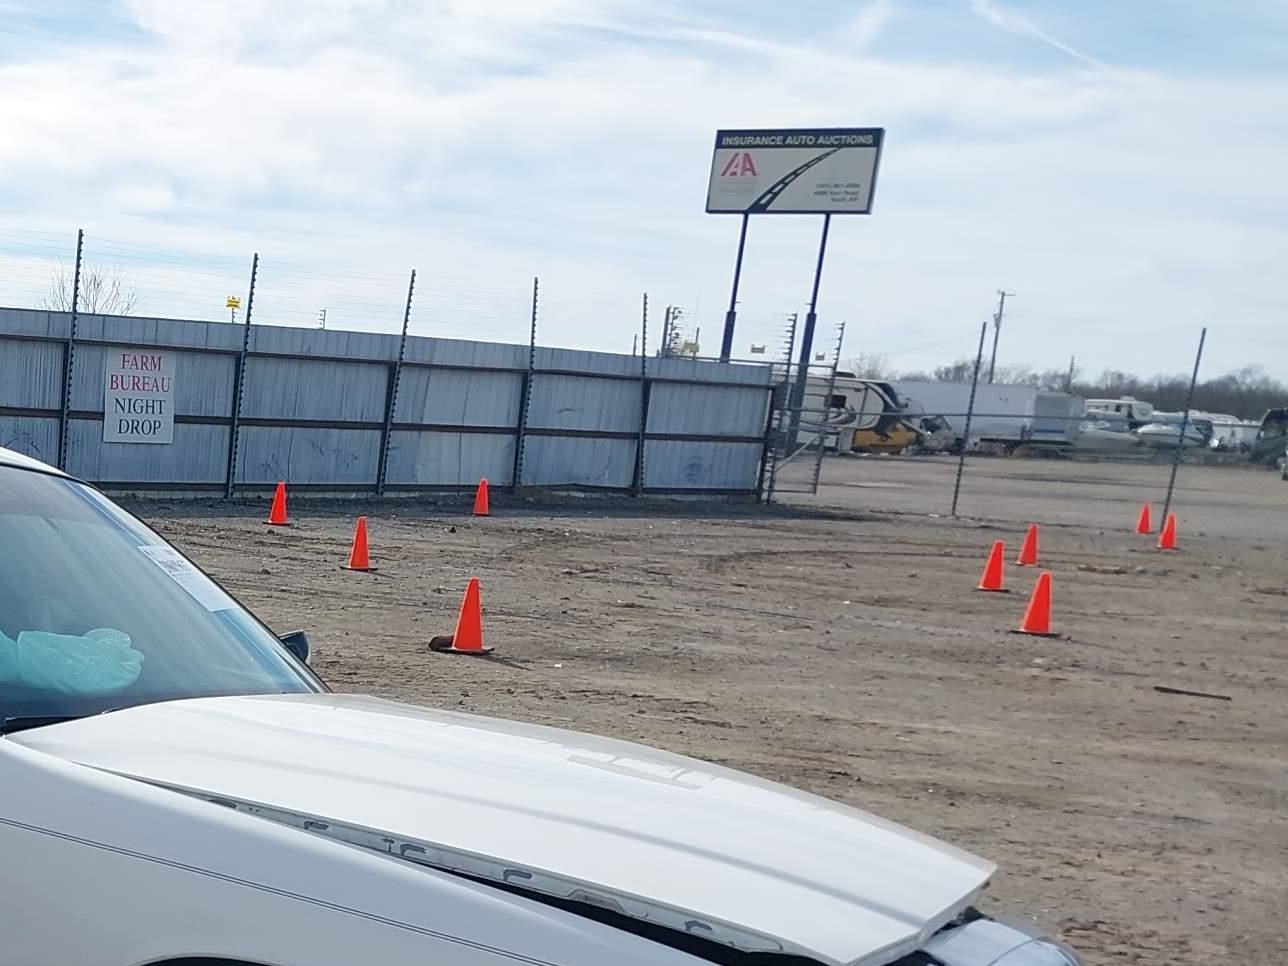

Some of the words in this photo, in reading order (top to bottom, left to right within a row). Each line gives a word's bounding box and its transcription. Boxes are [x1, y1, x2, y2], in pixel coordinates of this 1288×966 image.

[721, 135, 784, 146] INSURANCE
[785, 135, 816, 145] AUTO
[816, 134, 874, 145] AUCTIONS
[121, 353, 162, 372] FARM
[110, 374, 171, 393] BUREAU
[114, 397, 166, 415] NIGHT
[118, 418, 162, 436] DROP
